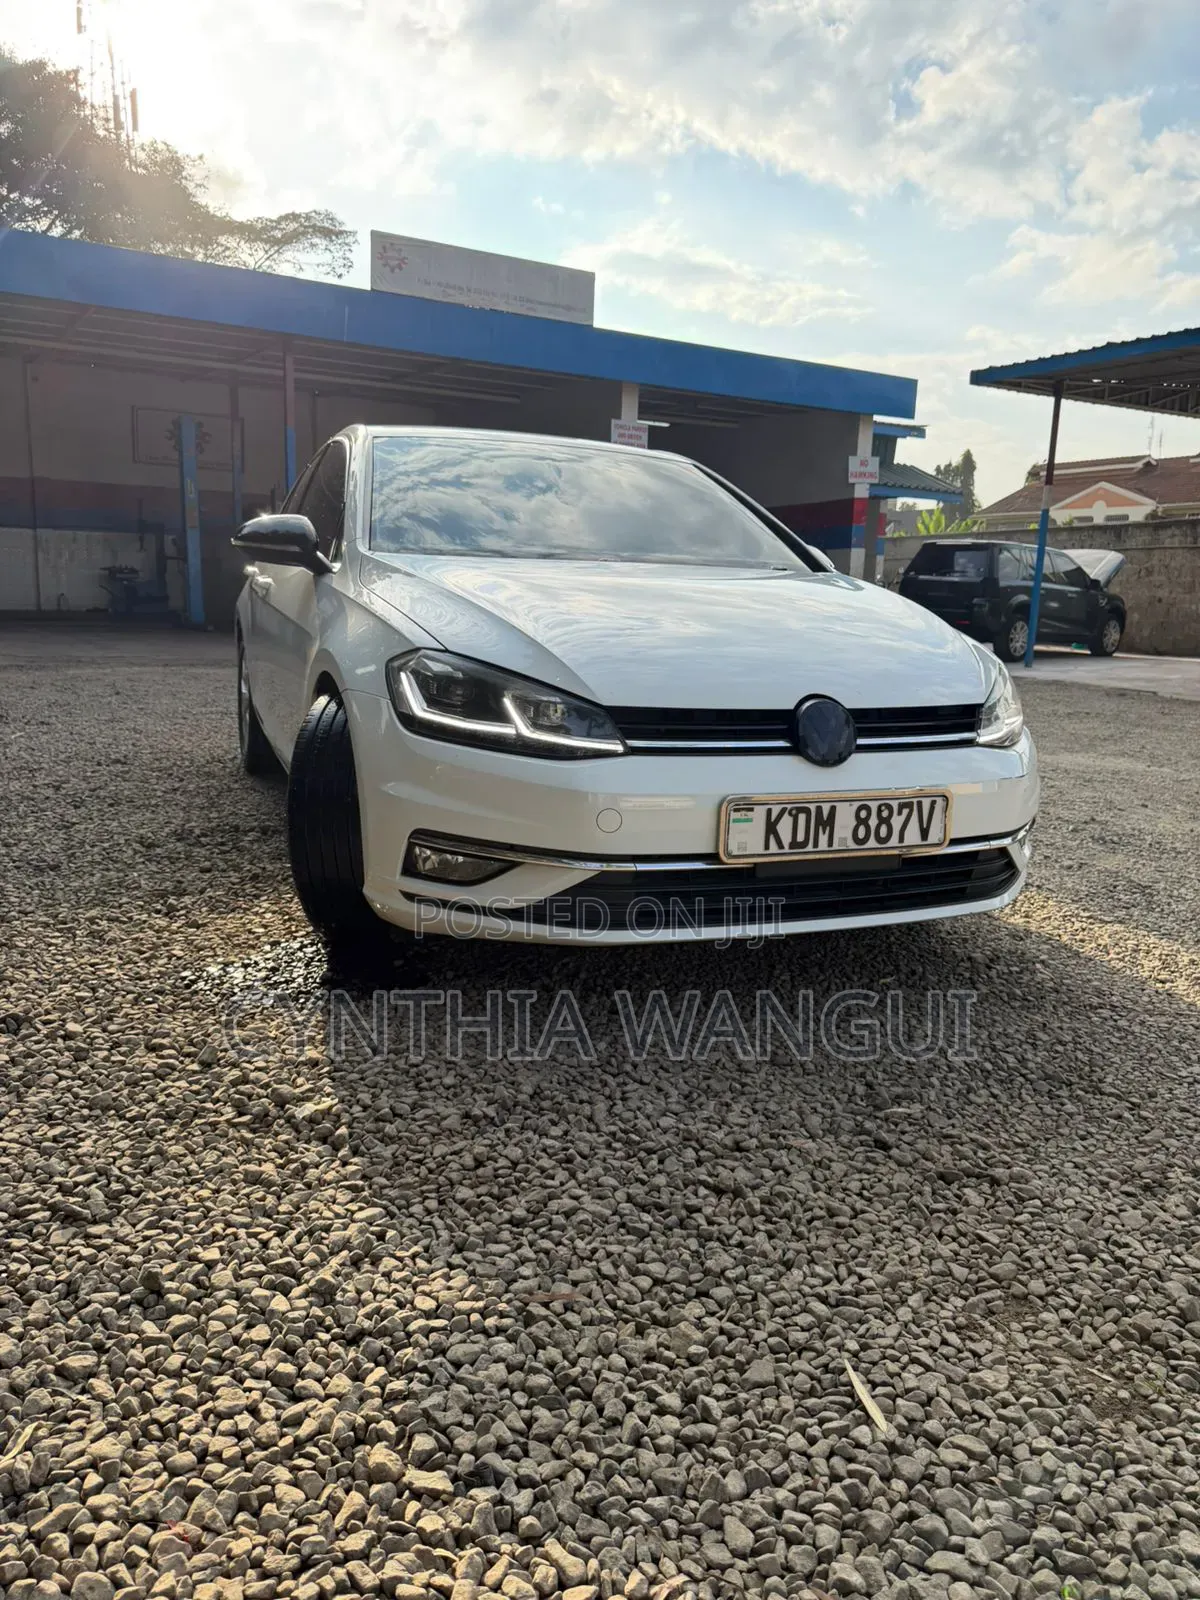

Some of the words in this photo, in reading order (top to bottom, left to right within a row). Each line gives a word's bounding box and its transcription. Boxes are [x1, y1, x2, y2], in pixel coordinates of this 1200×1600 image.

[860, 459, 869, 468] NO
[764, 803, 837, 850] KDM
[851, 799, 938, 846] 887V
